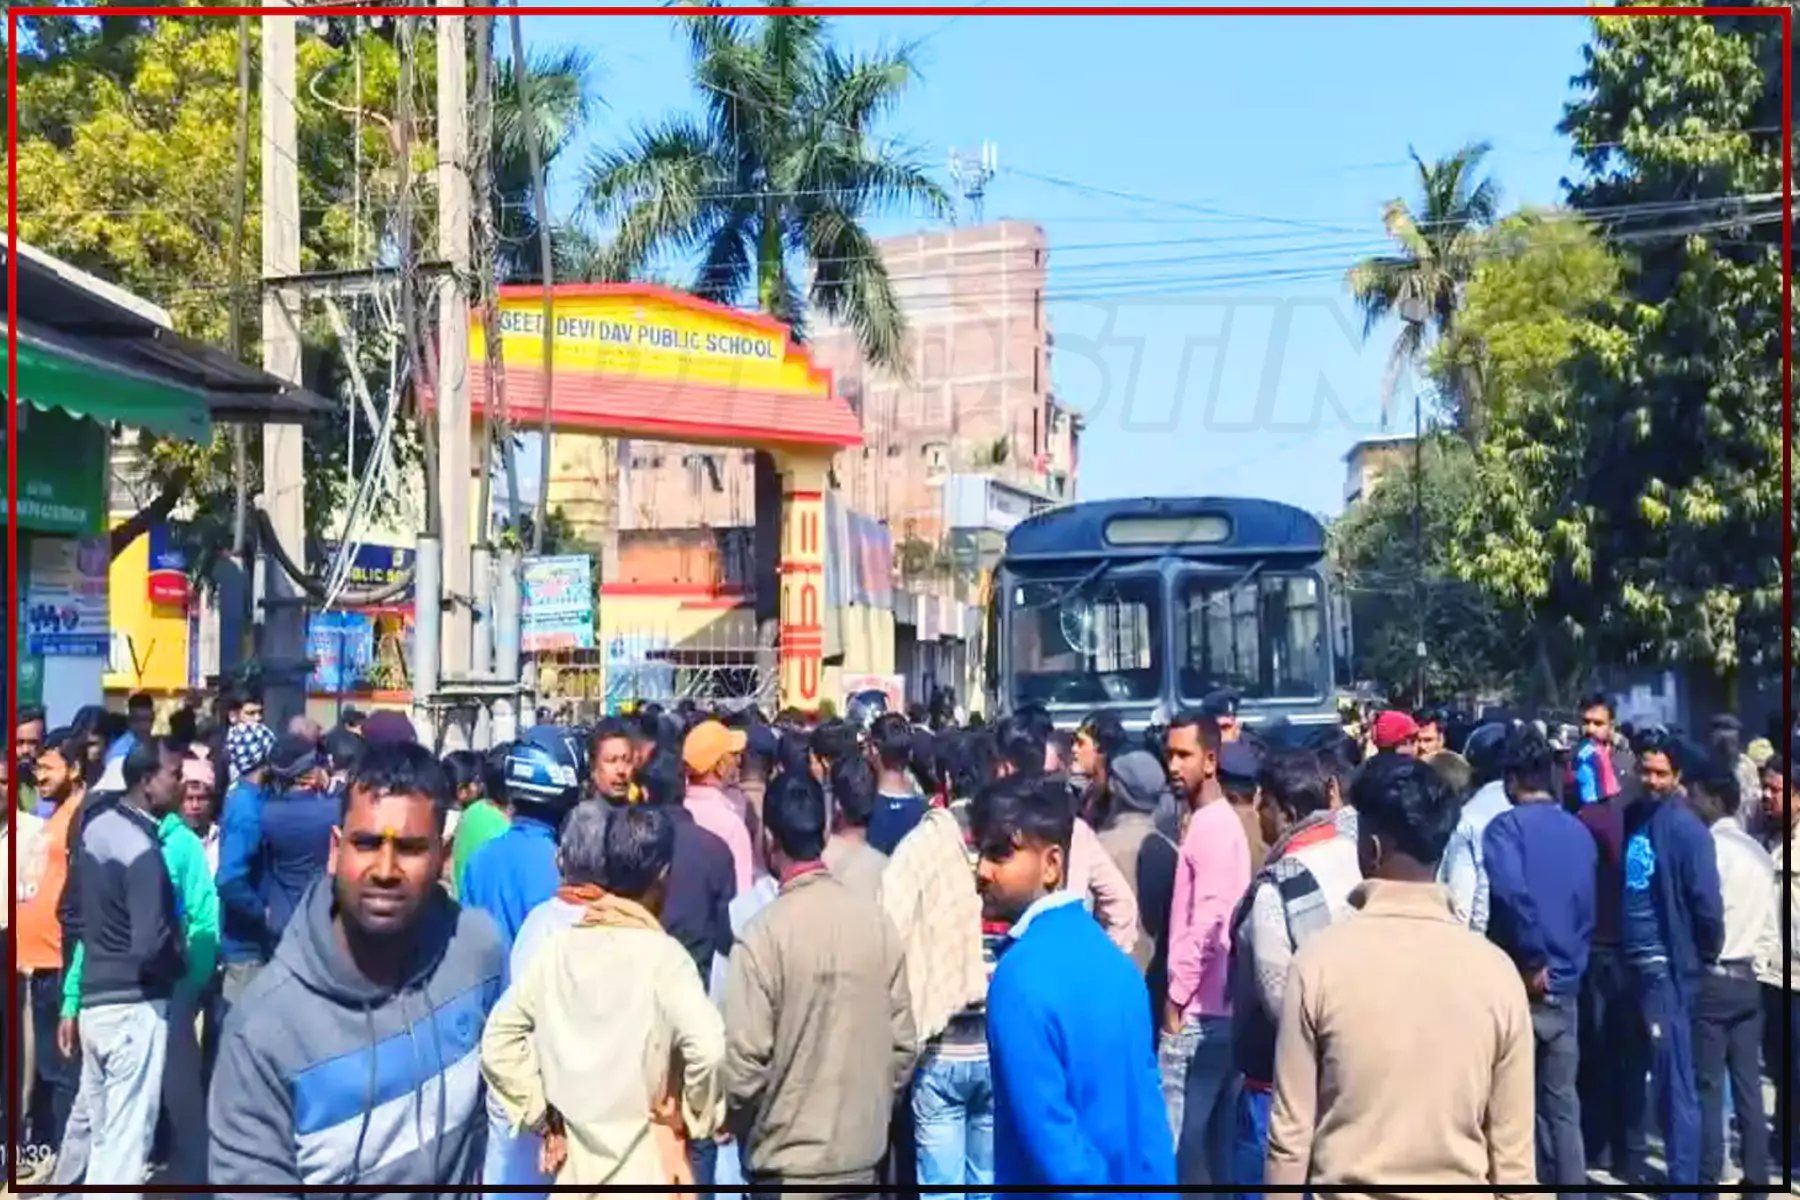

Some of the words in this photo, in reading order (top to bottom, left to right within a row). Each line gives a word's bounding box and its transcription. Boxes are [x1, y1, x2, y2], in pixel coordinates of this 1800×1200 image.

[557, 315, 595, 339] DEVI
[600, 320, 633, 344] DAV
[638, 325, 701, 350] PUBLIC
[706, 332, 777, 359] SCHOOL
